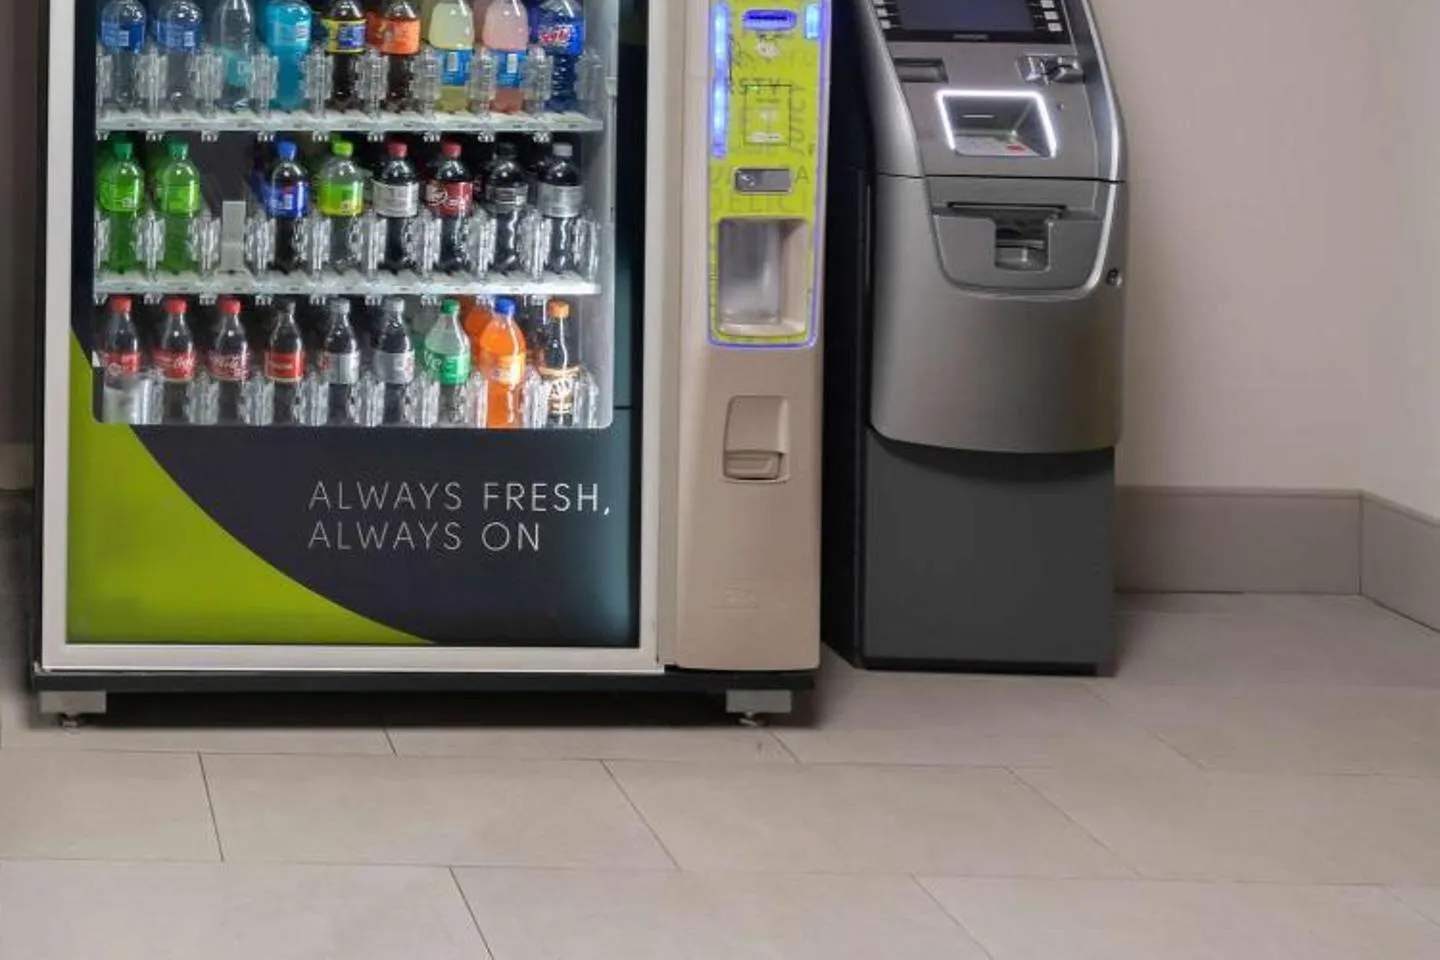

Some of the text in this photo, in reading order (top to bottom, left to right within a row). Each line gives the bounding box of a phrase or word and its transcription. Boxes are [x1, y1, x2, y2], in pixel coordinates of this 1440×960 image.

[309, 481, 610, 515] ALWAYS FRESH,
[308, 521, 540, 551] ALWAYS ON
